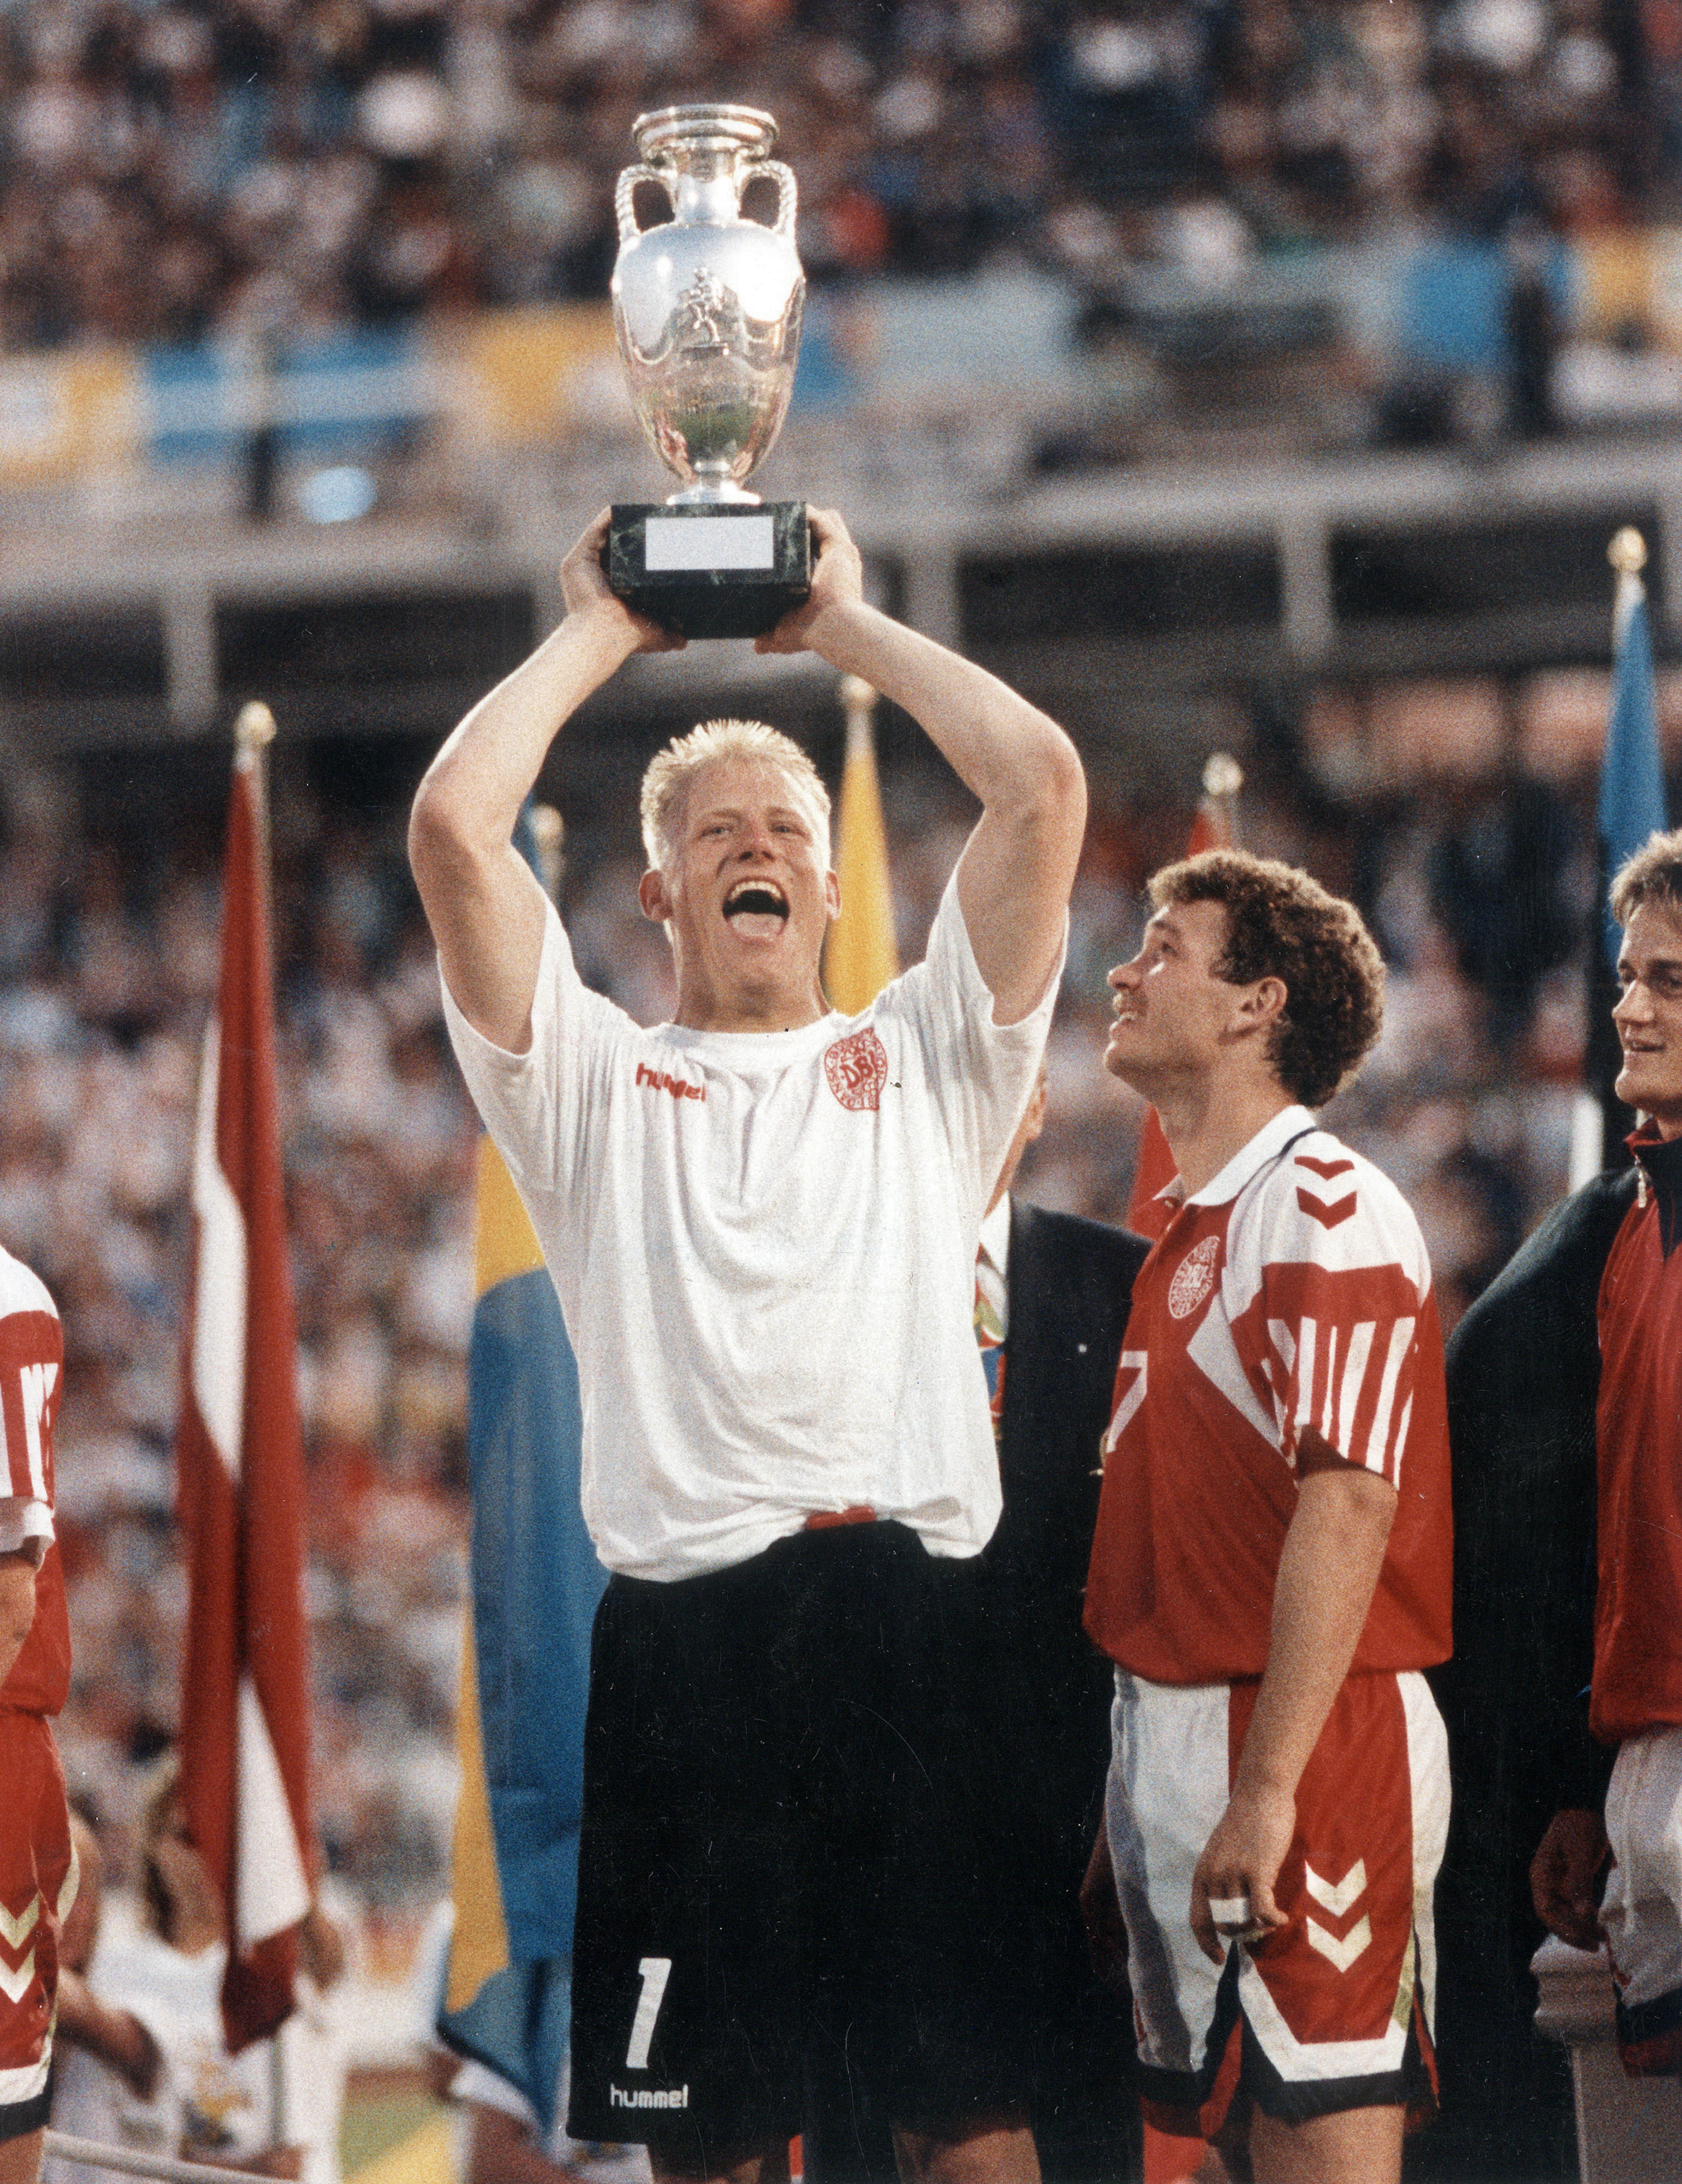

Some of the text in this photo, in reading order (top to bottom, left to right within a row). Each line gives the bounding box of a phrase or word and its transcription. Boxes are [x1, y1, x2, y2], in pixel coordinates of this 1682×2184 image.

[1106, 1351, 1148, 1453] 7
[626, 1958, 671, 2069] 1
[610, 2083, 688, 2108] hummel
